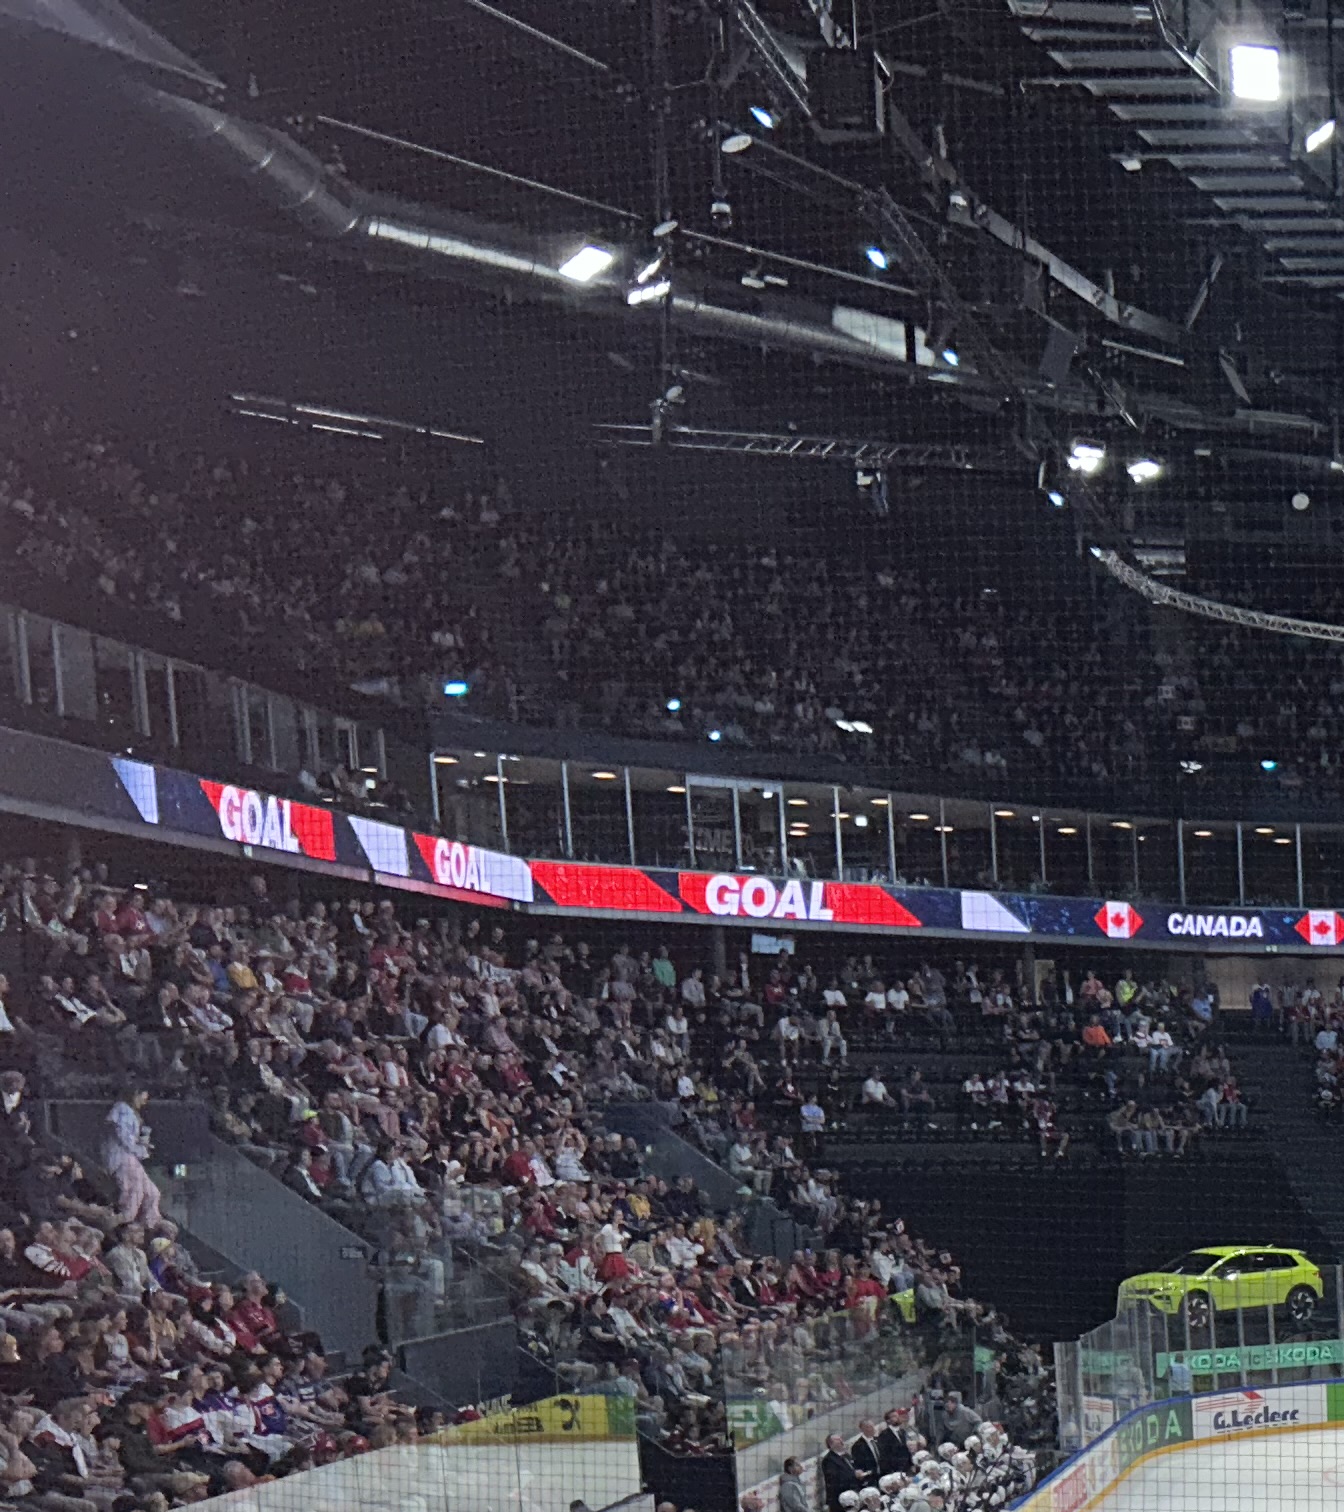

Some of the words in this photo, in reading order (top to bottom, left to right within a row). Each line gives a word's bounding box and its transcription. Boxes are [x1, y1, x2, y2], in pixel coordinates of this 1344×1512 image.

[219, 783, 299, 854] GOAL
[434, 837, 492, 893] GOAL
[704, 873, 834, 923] GOAL
[1166, 911, 1265, 940] CANADA
